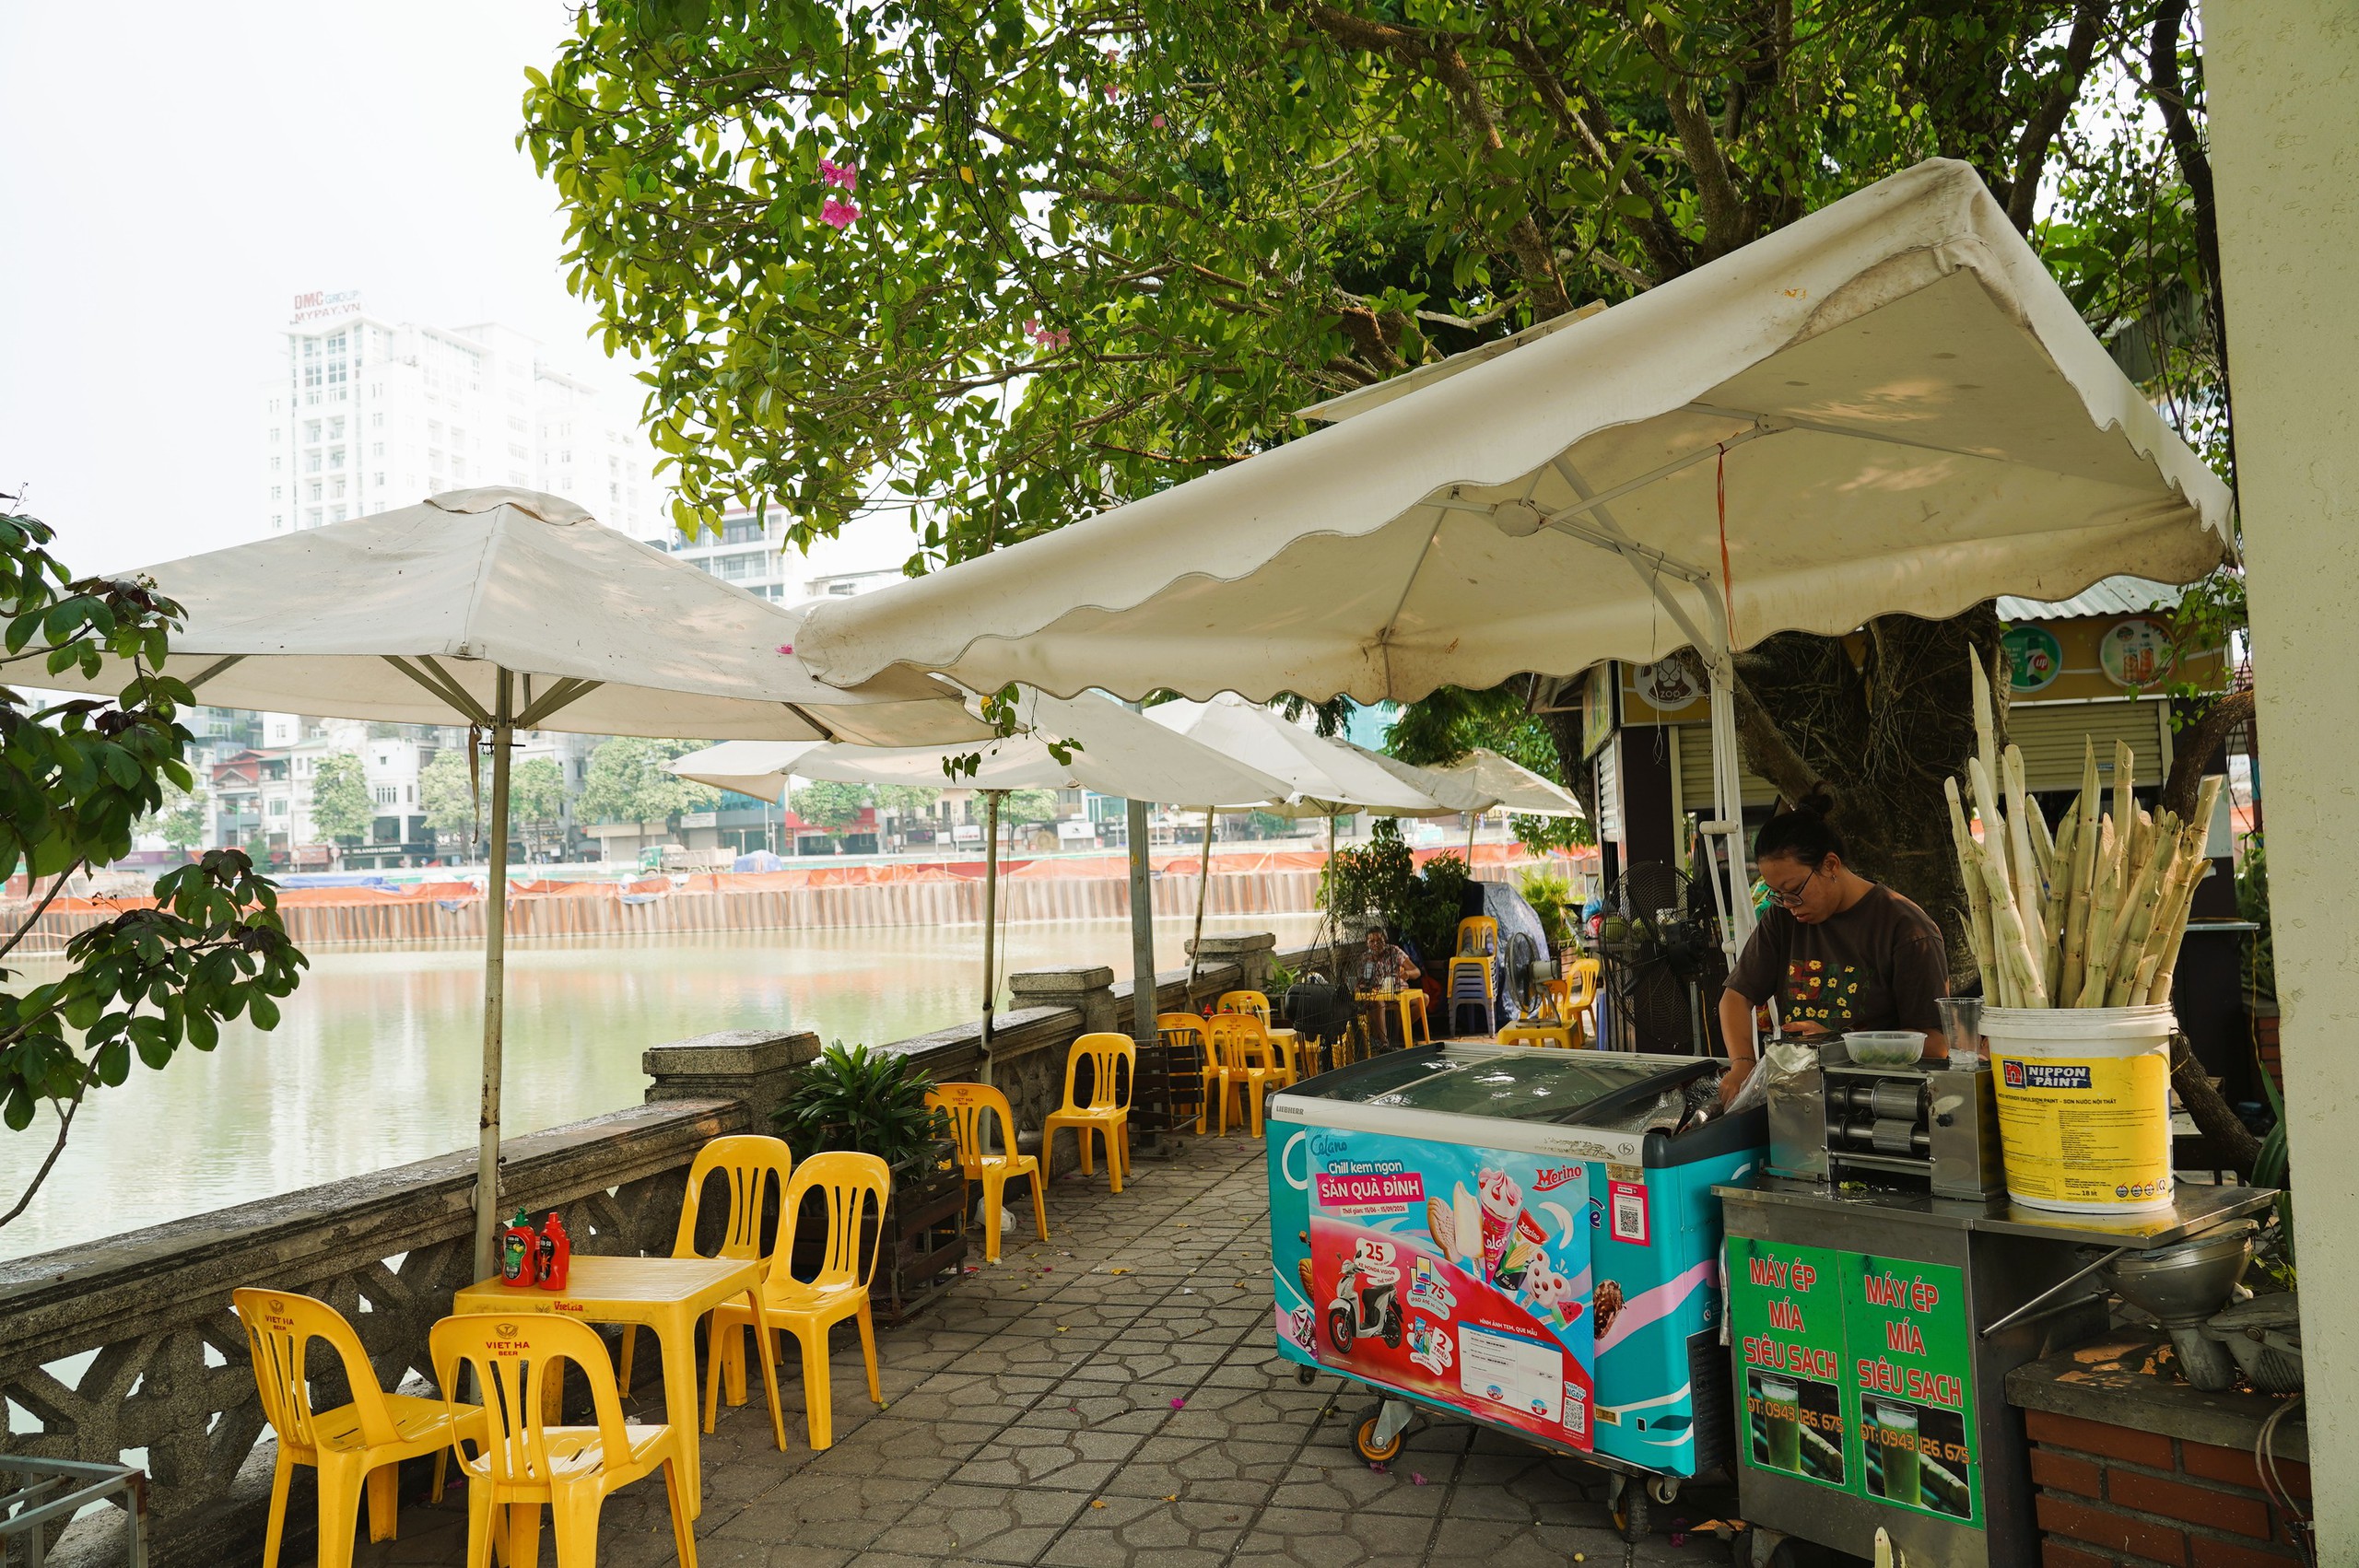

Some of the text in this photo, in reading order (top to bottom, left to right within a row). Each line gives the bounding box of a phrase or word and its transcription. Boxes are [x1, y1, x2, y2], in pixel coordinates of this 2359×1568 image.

[295, 291, 323, 310] DMC
[1660, 690, 1681, 698] ZOO
[2028, 1066, 2086, 1077] NIPPON
[2036, 1077, 2079, 1087] PAINT
[2020, 1095, 2043, 1104] EMULSION
[1275, 1106, 1305, 1116] LIEBHERR
[1309, 1134, 1348, 1156] Celano
[1328, 1161, 1402, 1176] Chill kem ngon
[1533, 1164, 1583, 1188] Merino
[1320, 1176, 1420, 1201] SĂN QUÀ ĐỈNH
[1520, 1220, 1541, 1241] Merino
[1365, 1242, 1384, 1262] 25
[1364, 1264, 1380, 1273] HONDA
[1379, 1268, 1395, 1276] VISION
[1749, 1253, 1816, 1293] MÁY ÉP
[1430, 1281, 1446, 1301] 75
[1863, 1270, 1940, 1314] MÁY ÉP
[264, 1314, 295, 1326] VIET HA
[1767, 1295, 1806, 1333] MÍA
[1479, 1317, 1492, 1327] HÌNH
[1492, 1319, 1503, 1328] ẢNH
[1515, 1326, 1526, 1335] QUE
[514, 1340, 530, 1349] HA
[1436, 1333, 1447, 1351] 2
[1885, 1316, 1927, 1357] MÍA
[1743, 1332, 1838, 1382] SIÊU SẠCH
[1857, 1355, 1964, 1410] SIÊU SẠCH
[1566, 1388, 1584, 1400] NGAY
